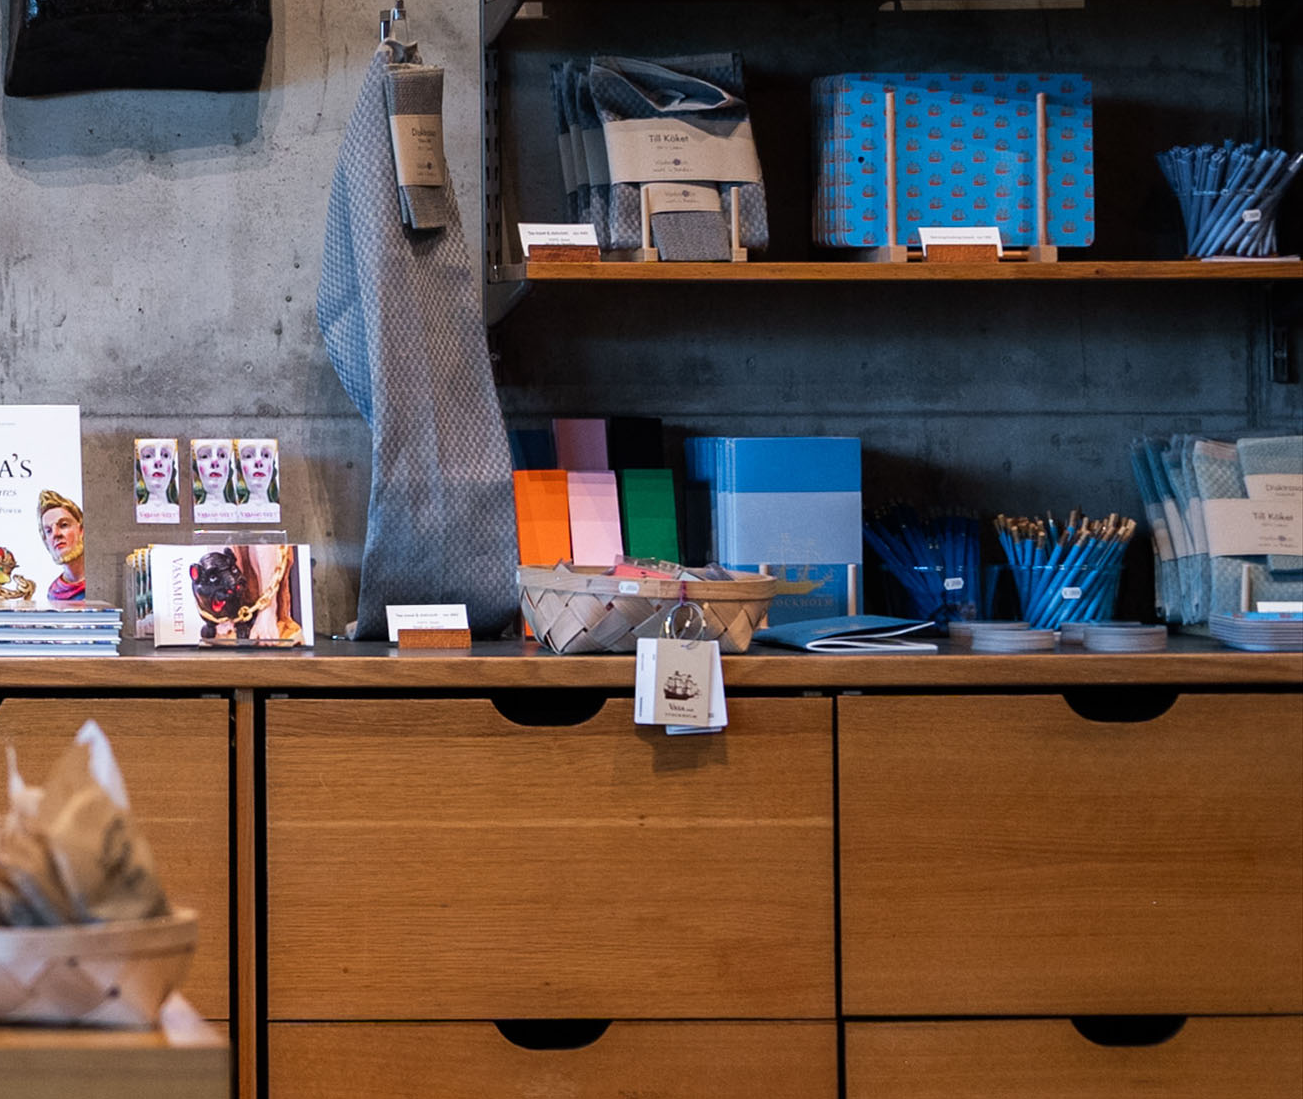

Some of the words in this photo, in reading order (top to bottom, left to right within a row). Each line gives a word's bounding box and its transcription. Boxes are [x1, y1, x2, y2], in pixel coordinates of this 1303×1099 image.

[648, 134, 662, 143] Till
[664, 133, 689, 143] Köket
[172, 557, 185, 635] VASAMUSEET
